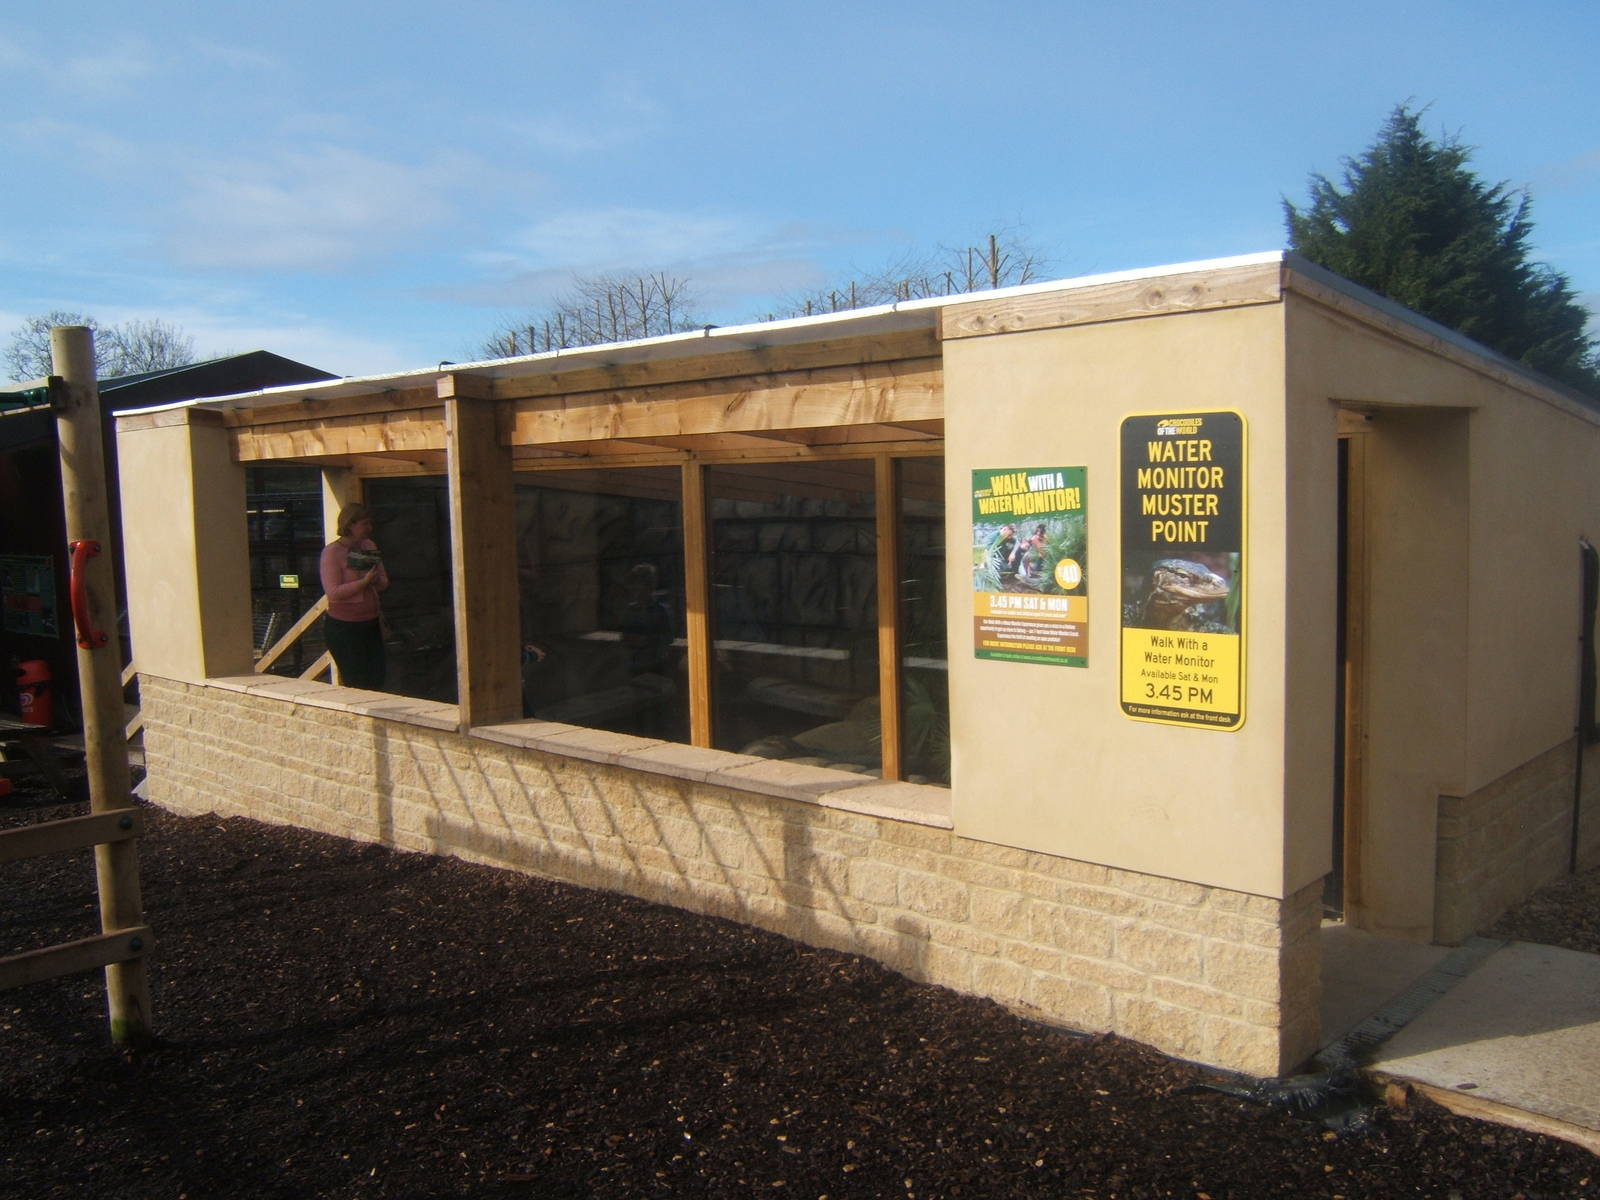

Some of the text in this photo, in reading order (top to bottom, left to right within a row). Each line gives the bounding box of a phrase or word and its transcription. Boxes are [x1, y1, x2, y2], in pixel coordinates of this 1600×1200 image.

[1147, 439, 1212, 463] WATER
[990, 472, 1028, 496] WALK
[1028, 473, 1055, 492] WITH
[1056, 472, 1065, 489] A
[1137, 466, 1224, 489] MONITOR
[978, 487, 1081, 515] WATER MONITOR!
[1142, 493, 1219, 516] MUSTER
[1151, 520, 1209, 543] POINT
[989, 595, 1008, 609] 3.45
[1008, 596, 1022, 609] PM
[1023, 597, 1039, 610] SAT
[1047, 598, 1068, 612] MON
[1150, 635, 1208, 651] Walk With a
[1144, 652, 1215, 668] Water Monitor
[1140, 669, 1219, 684] Available Sat & Mon
[1145, 683, 1214, 704] 3.45 PM
[1128, 705, 1137, 713] For
[1137, 706, 1151, 714] more
[1151, 708, 1180, 718] information
[1180, 711, 1189, 719] ask
[1195, 712, 1205, 720] the
[1205, 713, 1218, 722] front
[1218, 715, 1231, 723] desk
